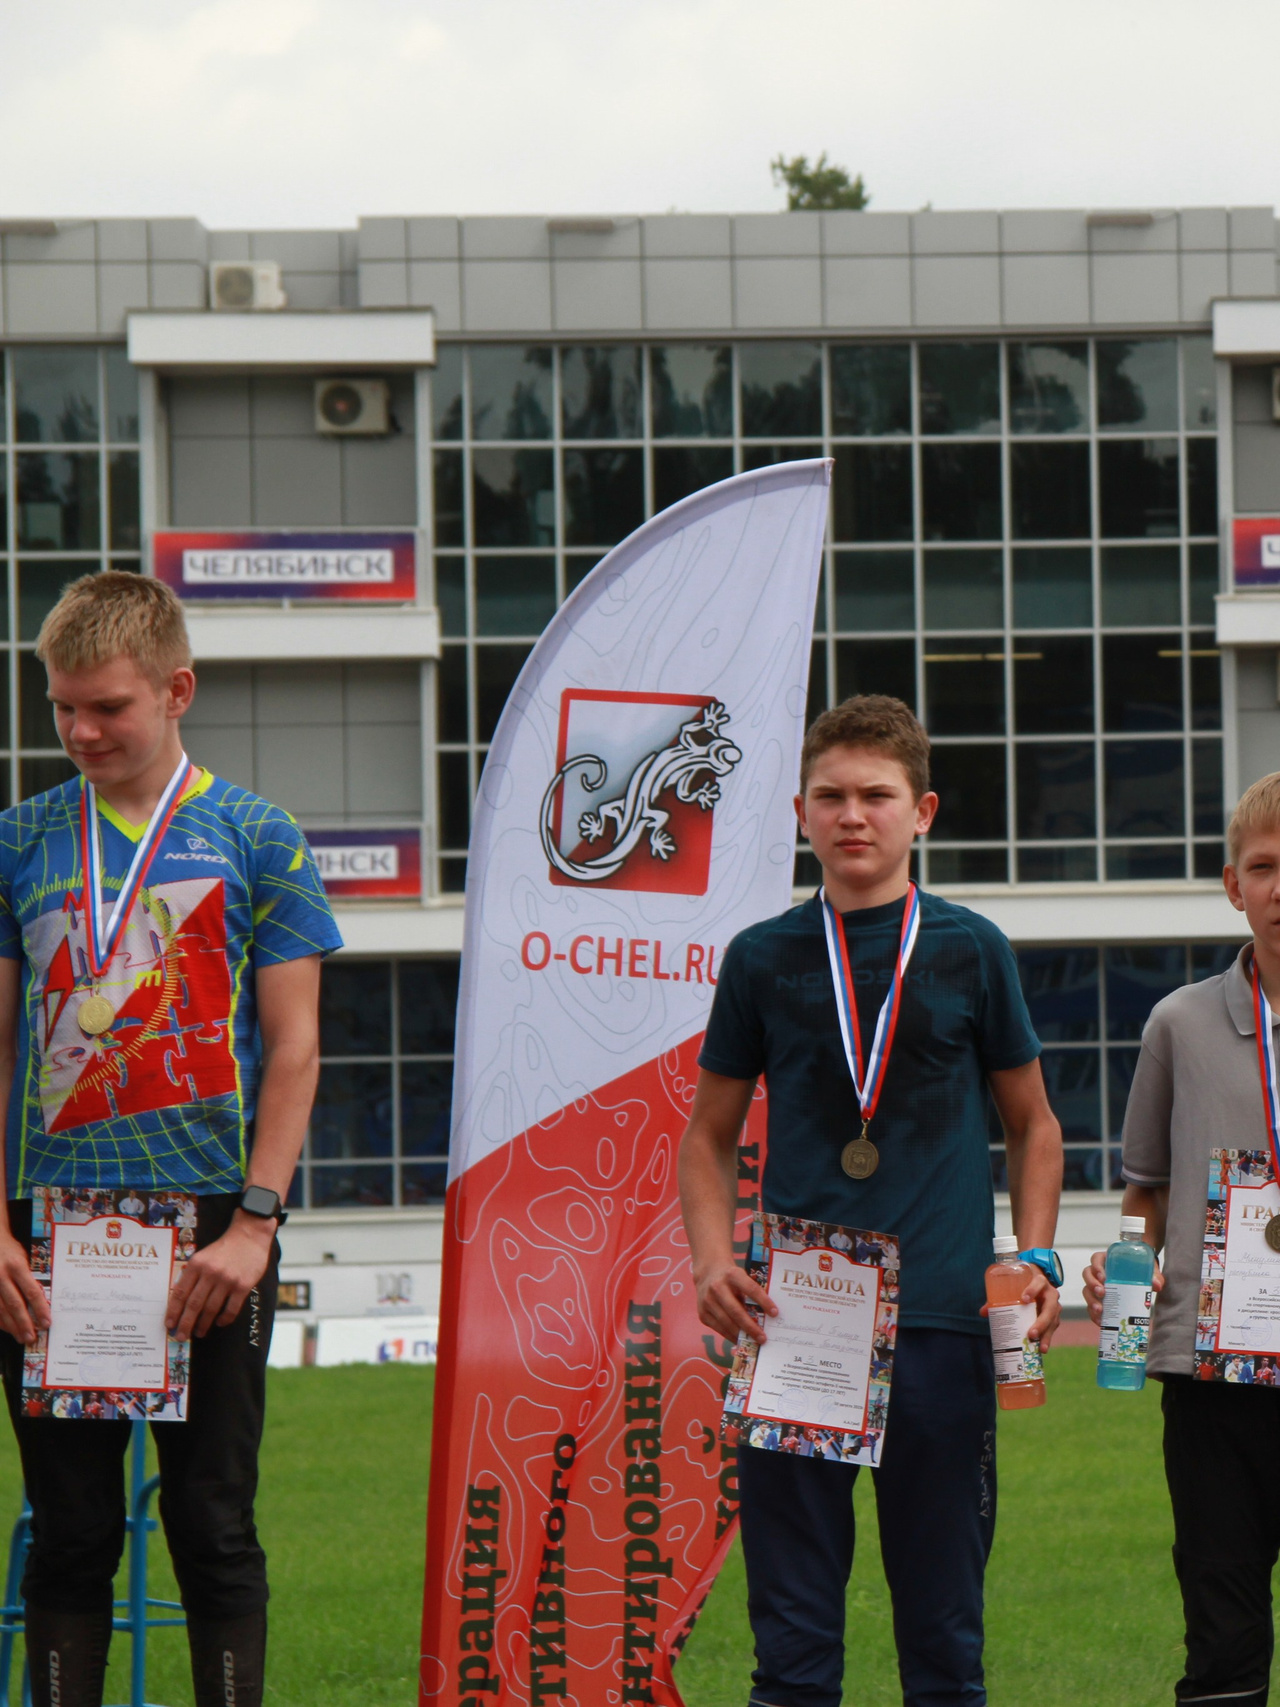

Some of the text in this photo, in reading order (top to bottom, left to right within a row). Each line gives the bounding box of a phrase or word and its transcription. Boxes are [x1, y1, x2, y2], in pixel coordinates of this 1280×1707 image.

[187, 552, 388, 579] ЧЕЛЯБИНСК
[163, 852, 228, 864] NORD
[520, 930, 730, 986] O-CHEL.RU
[775, 968, 935, 990] NODSKI
[66, 1241, 159, 1258] ГРАМОТА
[782, 1269, 865, 1296] ГРАМОТА
[819, 1360, 842, 1369] МЕСТО
[622, 1299, 673, 1707] нтирования
[530, 1432, 578, 1707] тивного
[457, 1485, 507, 1707] рация
